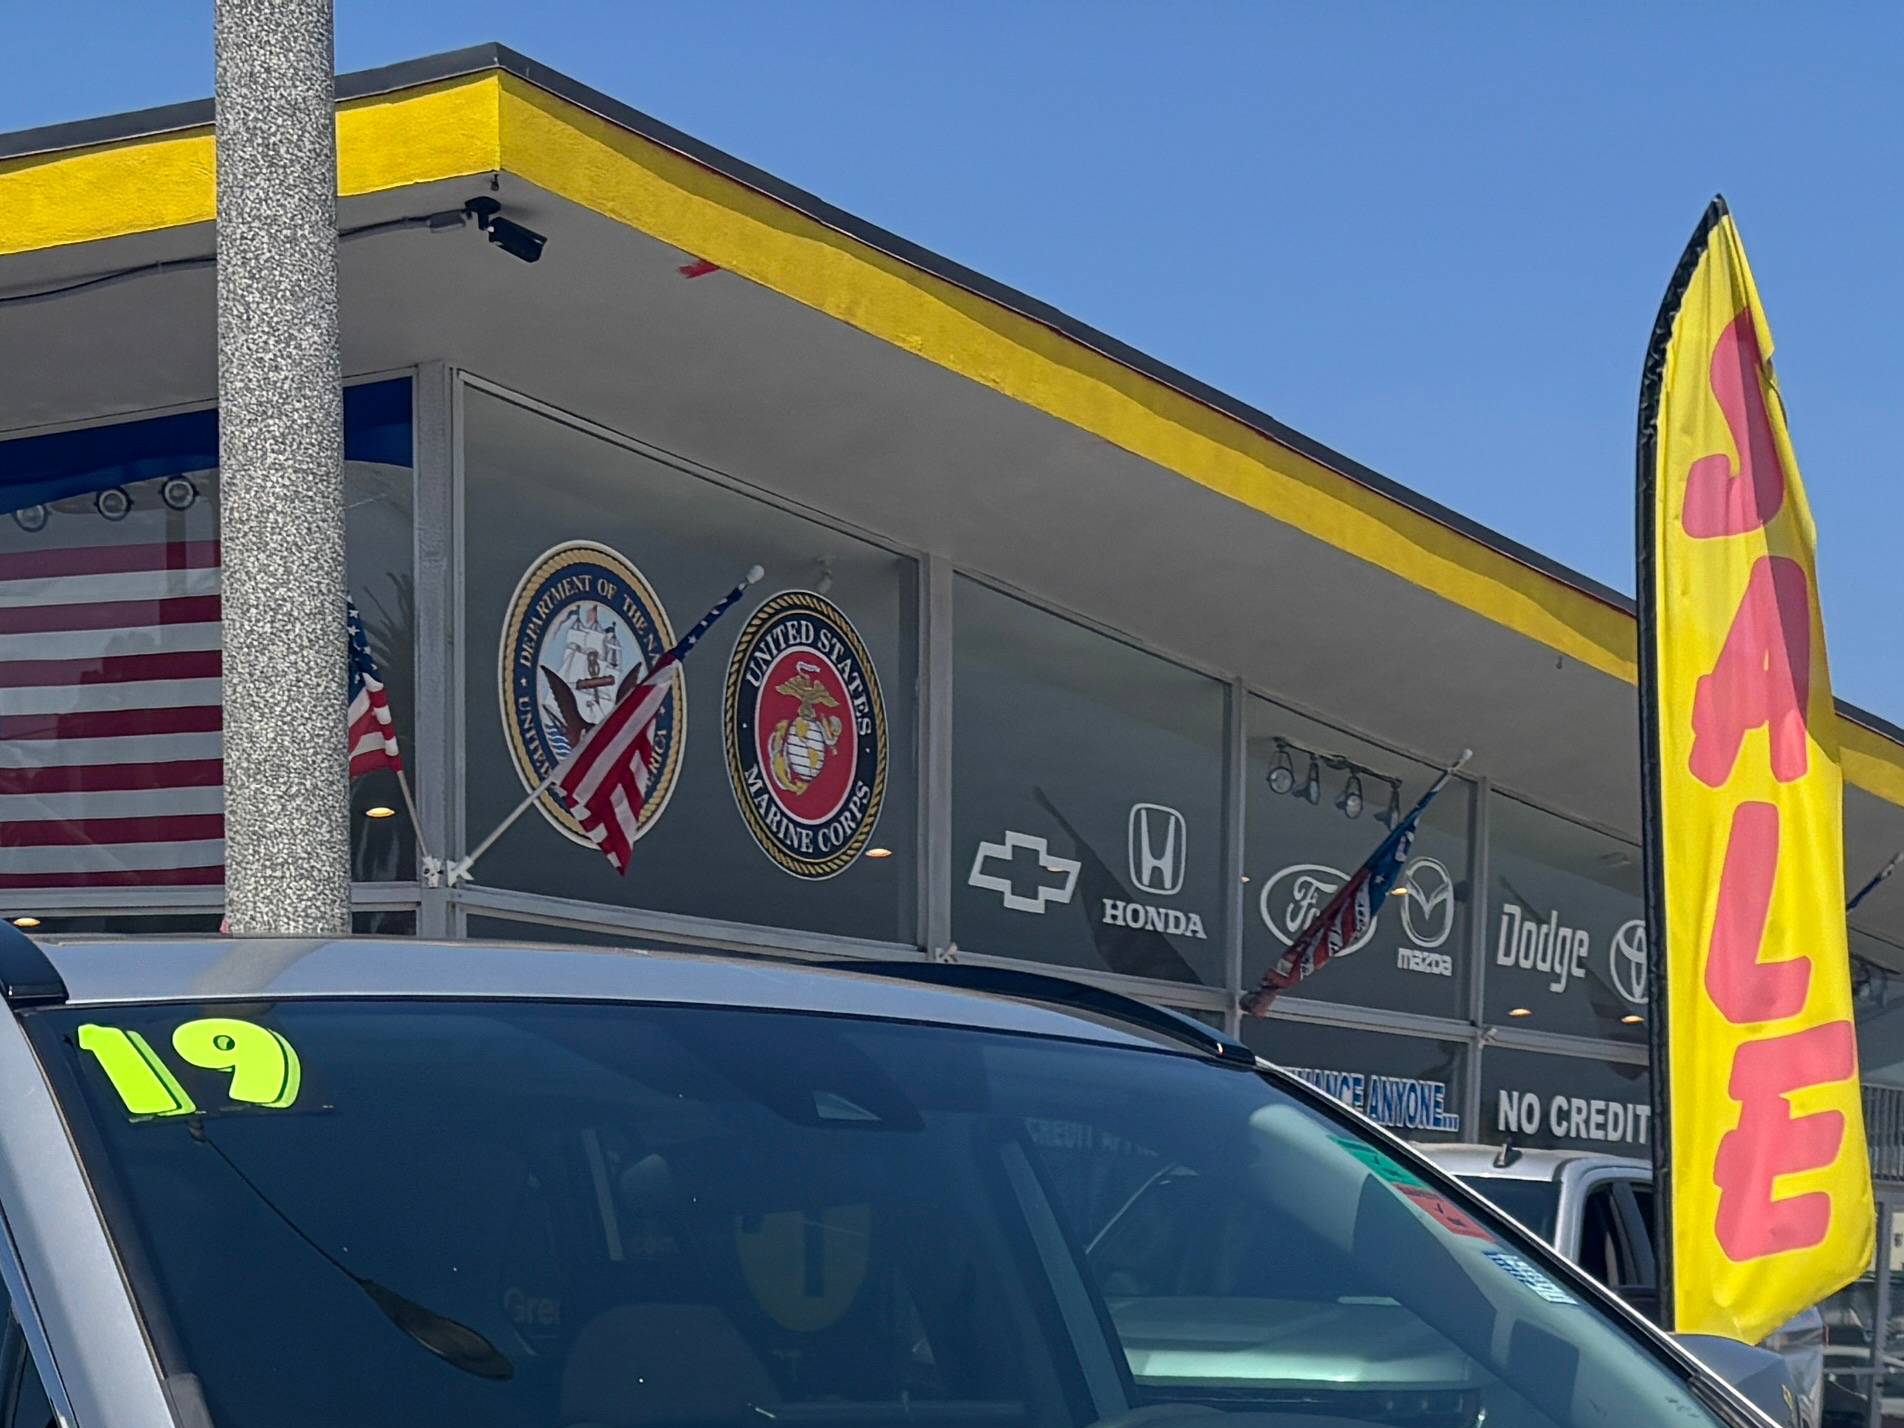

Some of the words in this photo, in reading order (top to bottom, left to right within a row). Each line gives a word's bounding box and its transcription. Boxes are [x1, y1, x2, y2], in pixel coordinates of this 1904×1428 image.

[520, 575, 592, 667] DEPARTMENT
[598, 578, 617, 600] OF
[623, 594, 648, 634] THE
[746, 621, 814, 688] UNITED
[818, 628, 872, 736] STATES
[745, 763, 813, 853] MARINE
[818, 781, 871, 852] CORPS
[1682, 304, 1855, 1262] SALE
[1101, 898, 1207, 940] HONDA
[1497, 903, 1589, 993] Dodge
[78, 1017, 301, 1116] 19
[1498, 1089, 1541, 1135] NO
[1550, 1095, 1651, 1144] CREDIT
